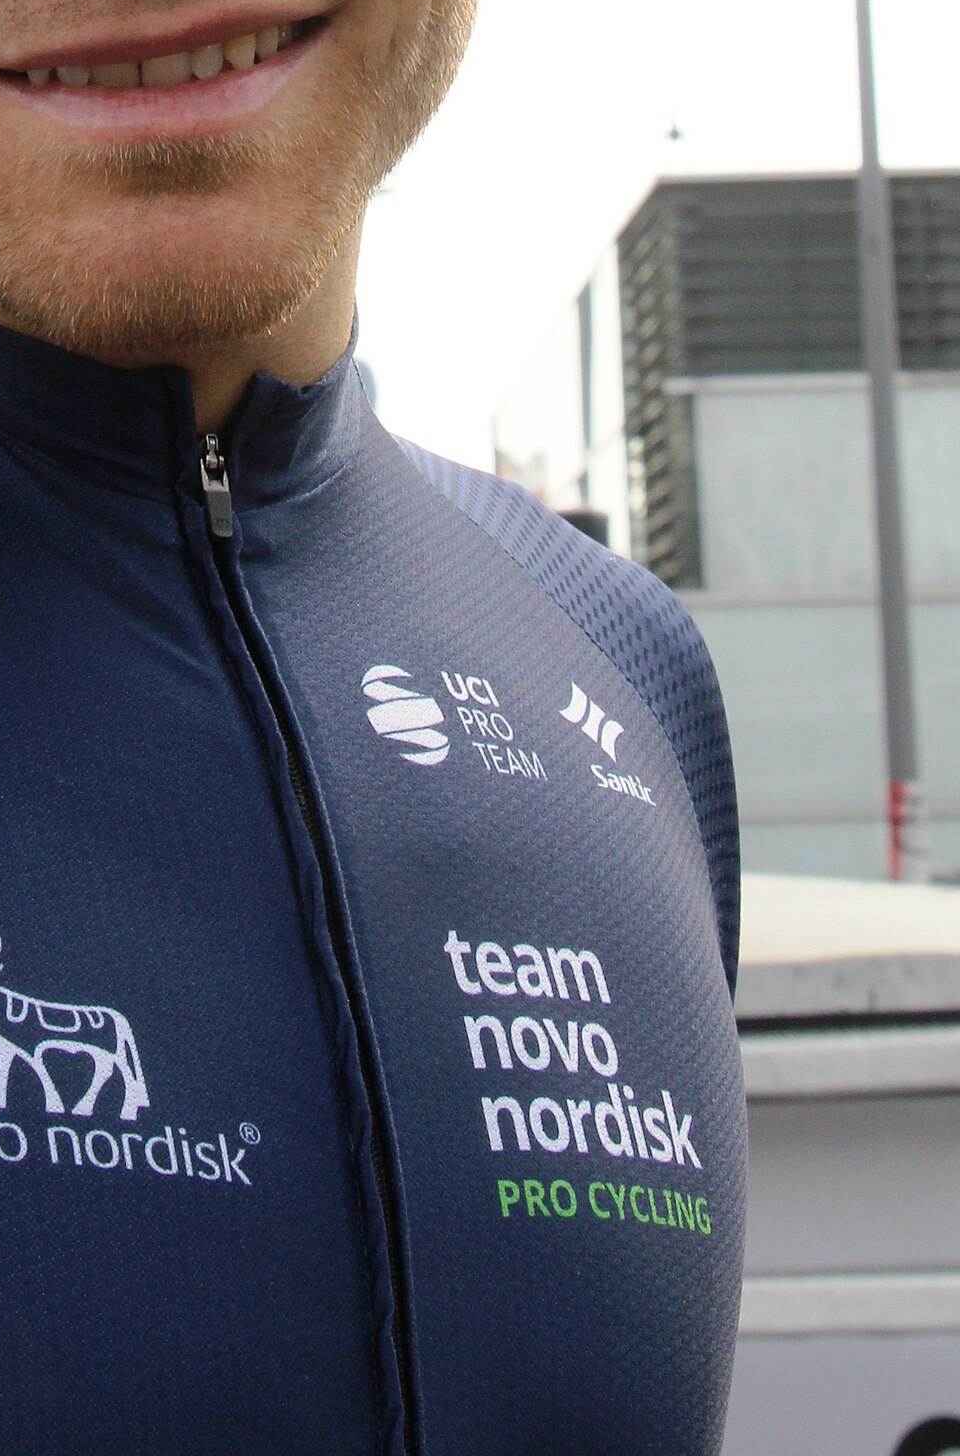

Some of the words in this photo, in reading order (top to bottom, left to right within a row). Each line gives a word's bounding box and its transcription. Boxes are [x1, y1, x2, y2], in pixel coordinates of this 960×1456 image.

[441, 670, 500, 707] UCI
[456, 706, 514, 742] PRO
[472, 742, 548, 781] TEAM
[591, 764, 657, 807] Santic
[443, 929, 612, 1004] team
[463, 1014, 620, 1077] novo
[481, 1082, 704, 1171] nordisk
[497, 1179, 578, 1218] PRO
[589, 1181, 713, 1235] CYCLING
